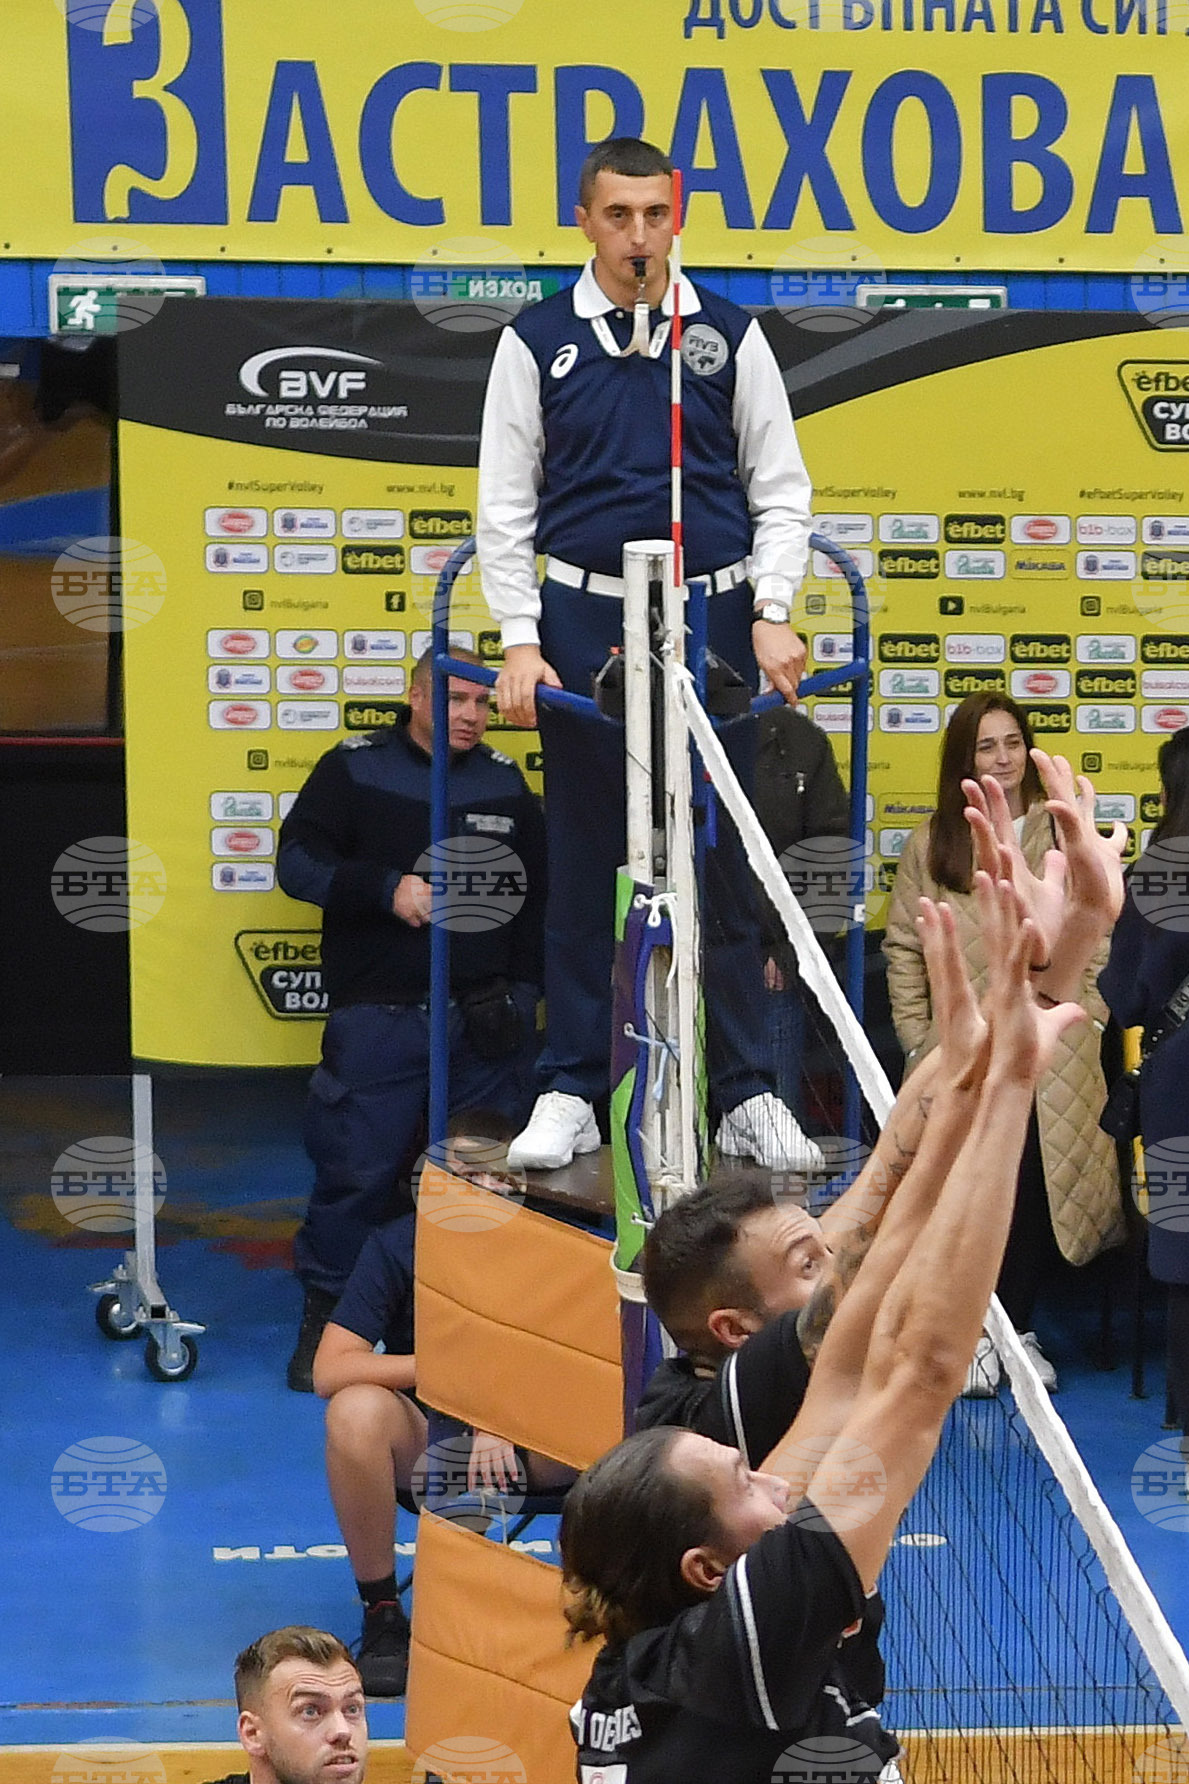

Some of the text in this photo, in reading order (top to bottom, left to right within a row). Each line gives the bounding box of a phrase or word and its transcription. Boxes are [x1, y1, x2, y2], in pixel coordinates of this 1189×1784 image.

[469, 279, 543, 300] ИЗХОД
[279, 370, 367, 399] BVF
[225, 403, 408, 418] БЪЛГАРСКА ФЕДЕРАЦИЯ
[412, 515, 472, 535] efbet
[948, 521, 1005, 539] efbet
[345, 552, 404, 569] efbet
[882, 556, 939, 574] efbet
[882, 640, 940, 659] efbet
[1012, 640, 1071, 659] efbet
[948, 676, 1005, 692] efbet
[1077, 676, 1136, 693] efbet
[348, 706, 397, 726] efbe
[1028, 711, 1071, 728] fbet
[251, 940, 322, 962] efbe
[271, 970, 322, 990] СУП
